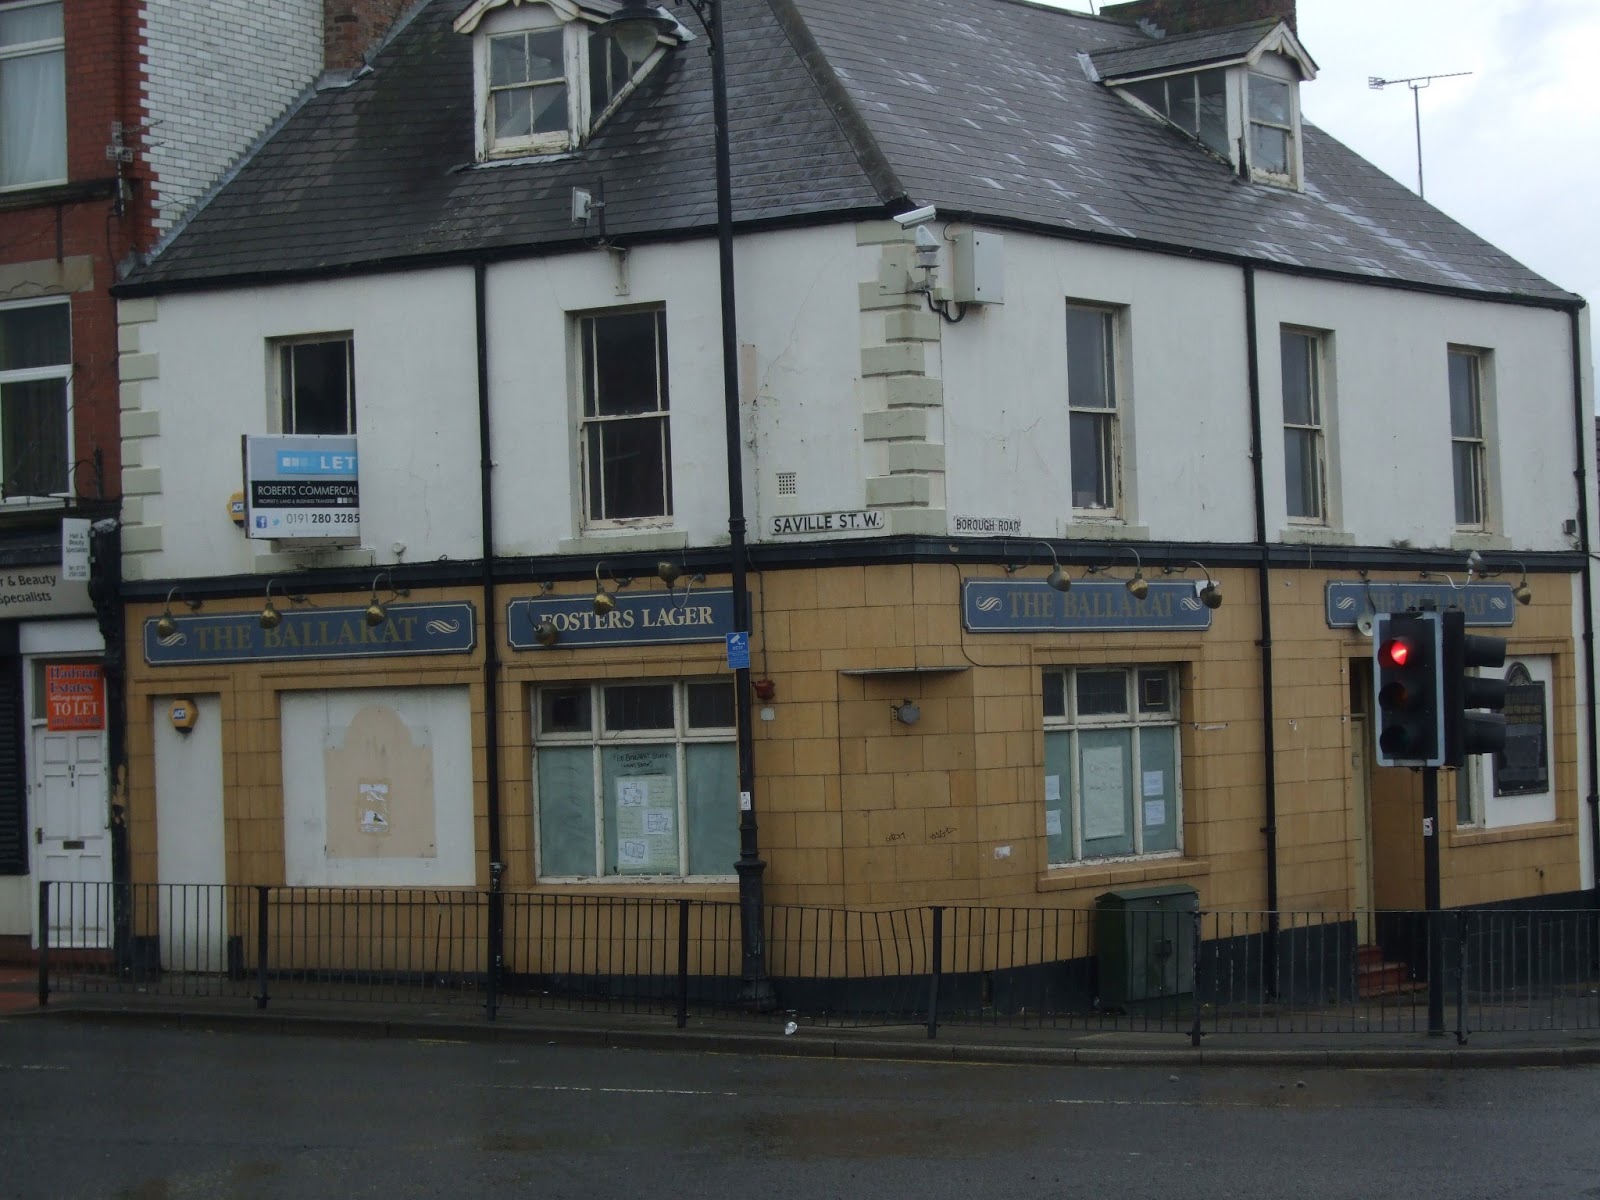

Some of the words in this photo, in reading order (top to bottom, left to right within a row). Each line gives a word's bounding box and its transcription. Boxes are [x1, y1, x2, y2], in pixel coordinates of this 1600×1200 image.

[320, 456, 357, 469] LET
[258, 486, 297, 496] ROBERTS
[298, 486, 358, 496] COMMERCIAL
[286, 513, 309, 524] 0191
[311, 513, 331, 524] 280
[334, 513, 360, 524] 3285
[774, 515, 833, 533] SAVILLE
[839, 513, 859, 528] ST.
[863, 512, 880, 527] W.
[956, 518, 995, 531] BOROUGH
[998, 520, 1020, 532] ROAD
[8, 576, 16, 586] &
[18, 575, 56, 587] Beauty
[1007, 591, 1054, 618] THE
[1063, 591, 1175, 618] BALLARAT
[641, 606, 715, 628] LAGER
[193, 624, 253, 651] THE
[264, 616, 418, 648] BALLARAT
[50, 666, 100, 679] Hadrian
[50, 681, 93, 693] Estates
[53, 702, 71, 716] TO
[74, 701, 99, 716] LET
[173, 709, 186, 718] ADT
